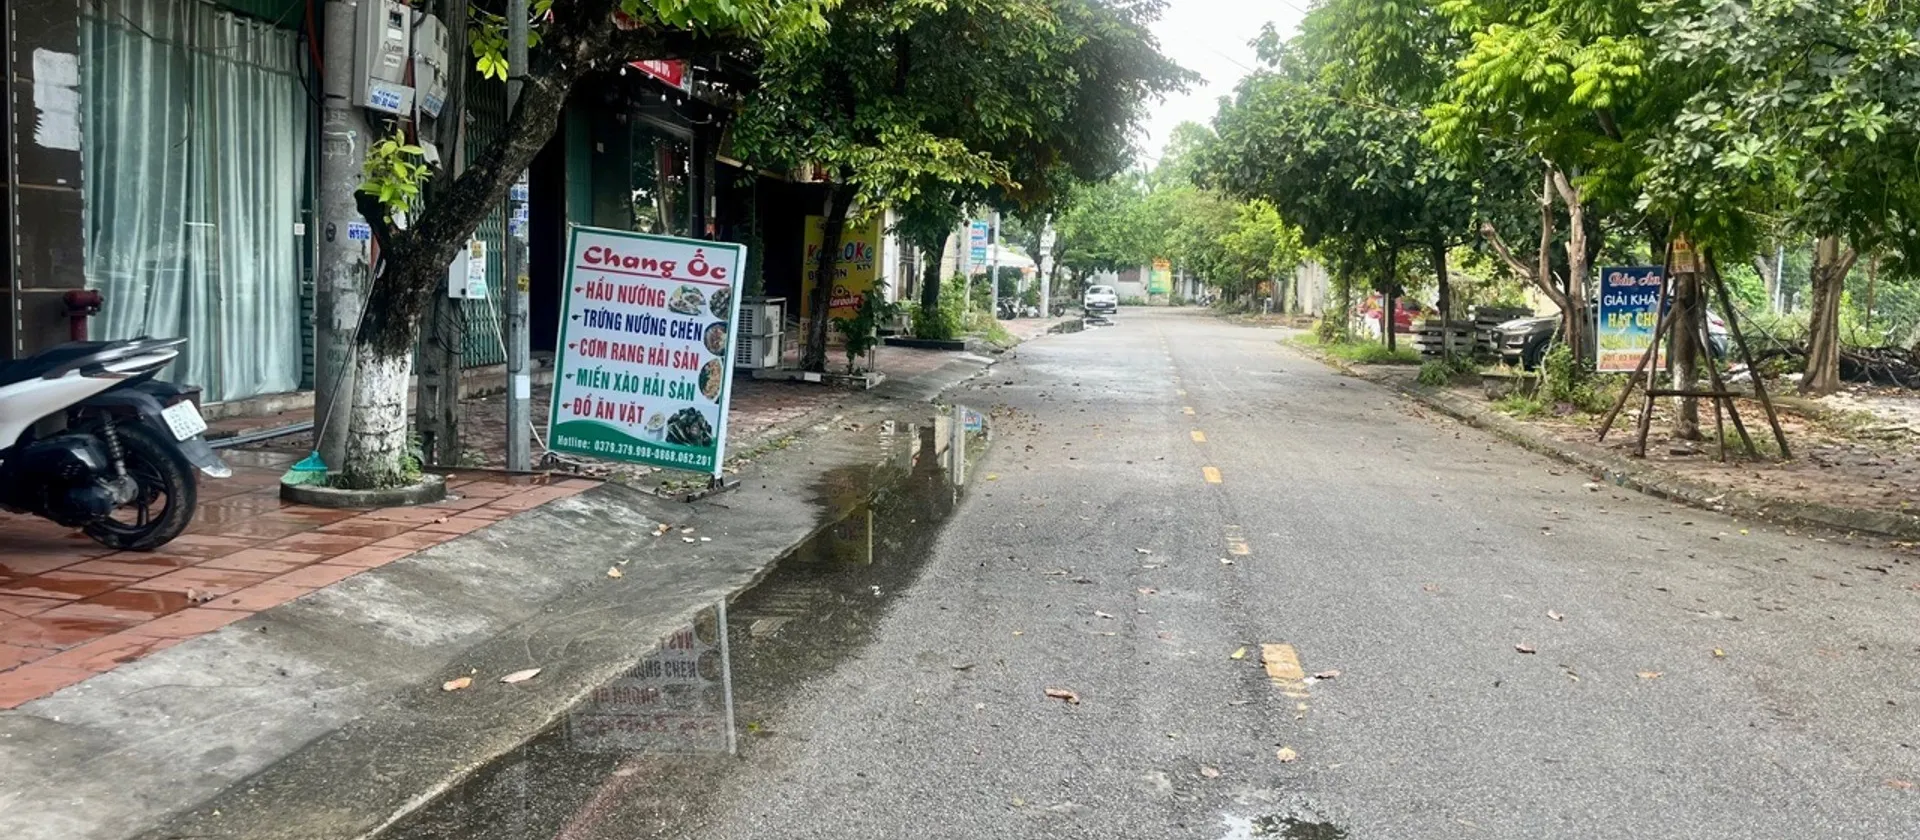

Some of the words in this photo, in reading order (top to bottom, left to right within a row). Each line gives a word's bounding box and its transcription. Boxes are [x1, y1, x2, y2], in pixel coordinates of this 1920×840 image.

[583, 246, 677, 279] Chang
[687, 248, 726, 280] Ốc
[586, 276, 613, 302] HẤU
[617, 283, 666, 309] NƯỚNG
[1603, 291, 1628, 306] GIẢI
[583, 307, 622, 331] TRỨNG
[625, 314, 667, 337] NƯỚNG
[670, 317, 703, 342] CHÉN
[579, 338, 608, 359] CƠM
[610, 342, 644, 364] RANG
[647, 341, 669, 367] HẢI
[673, 345, 700, 371] SẢN
[576, 365, 611, 390] MIẾN
[613, 370, 639, 395] XÀO
[642, 371, 665, 397] HẢI
[668, 374, 696, 402] SẢN
[595, 396, 617, 421] ĂN
[619, 400, 645, 428] VẶT
[557, 434, 591, 450] Hotline:
